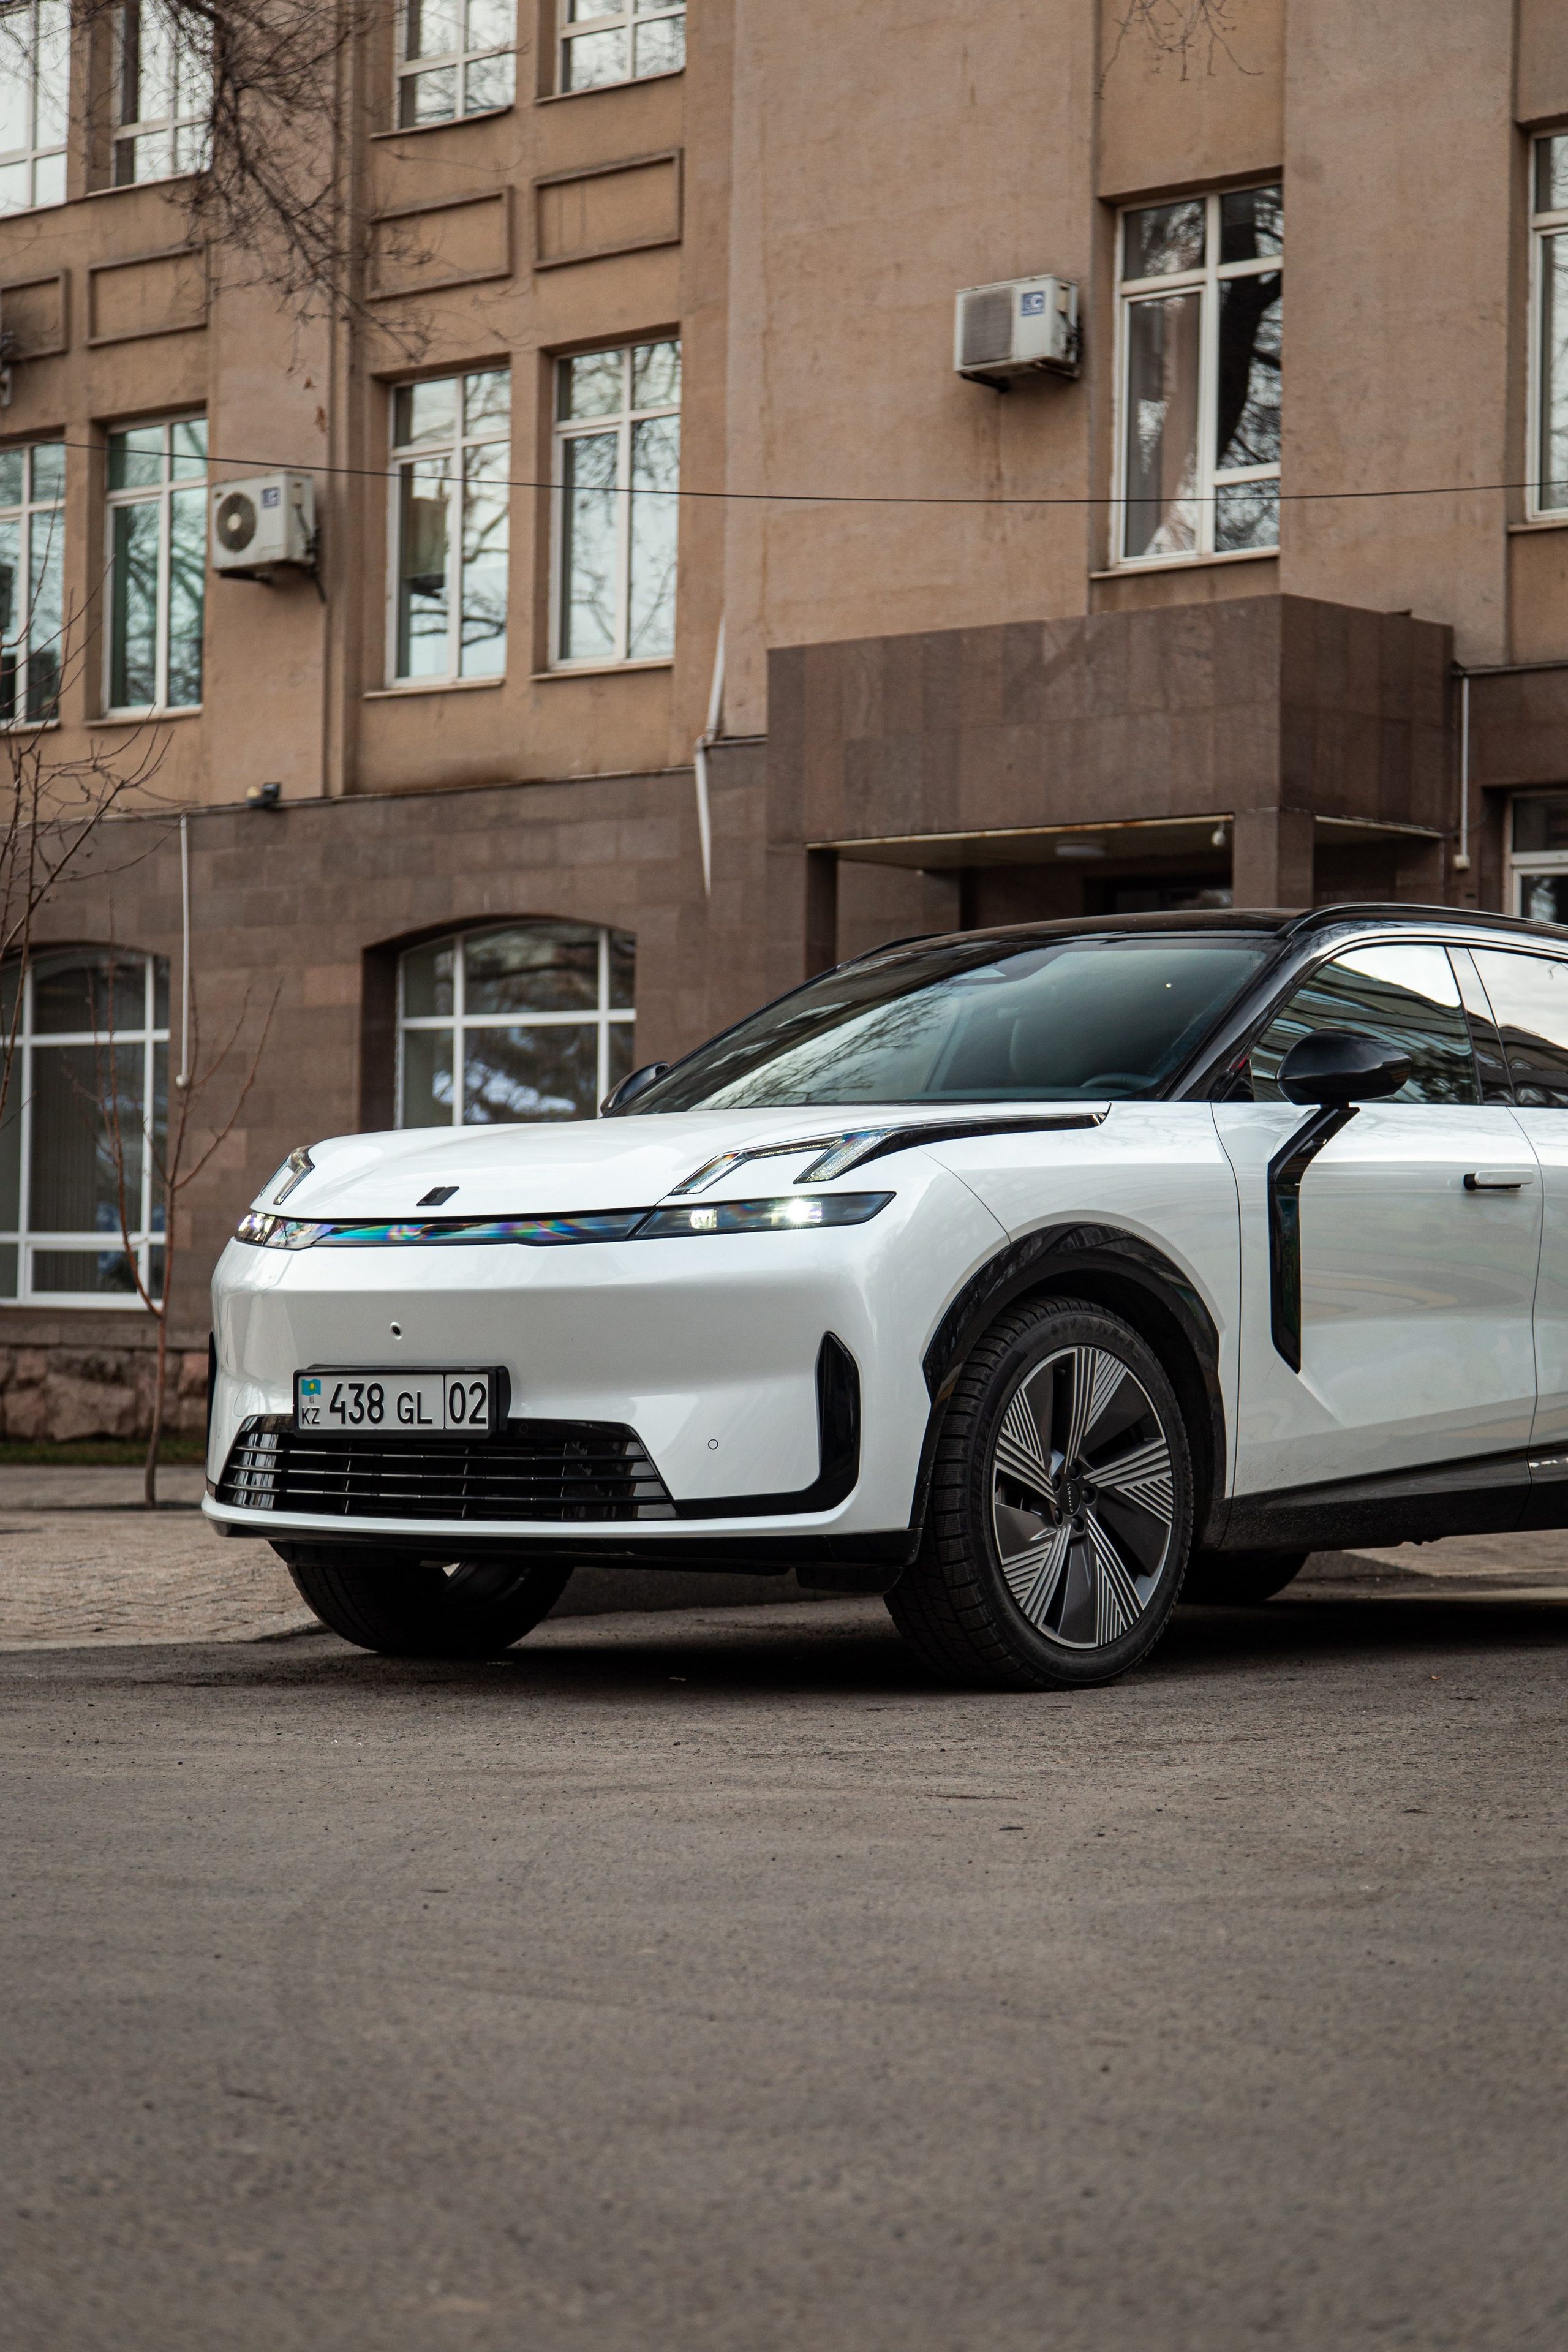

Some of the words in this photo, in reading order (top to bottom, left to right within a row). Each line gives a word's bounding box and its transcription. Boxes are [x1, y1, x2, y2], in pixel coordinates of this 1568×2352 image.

[302, 1407, 320, 1425] KZ
[329, 1382, 385, 1425] 438
[397, 1392, 433, 1425] GL
[449, 1381, 487, 1425] 02
